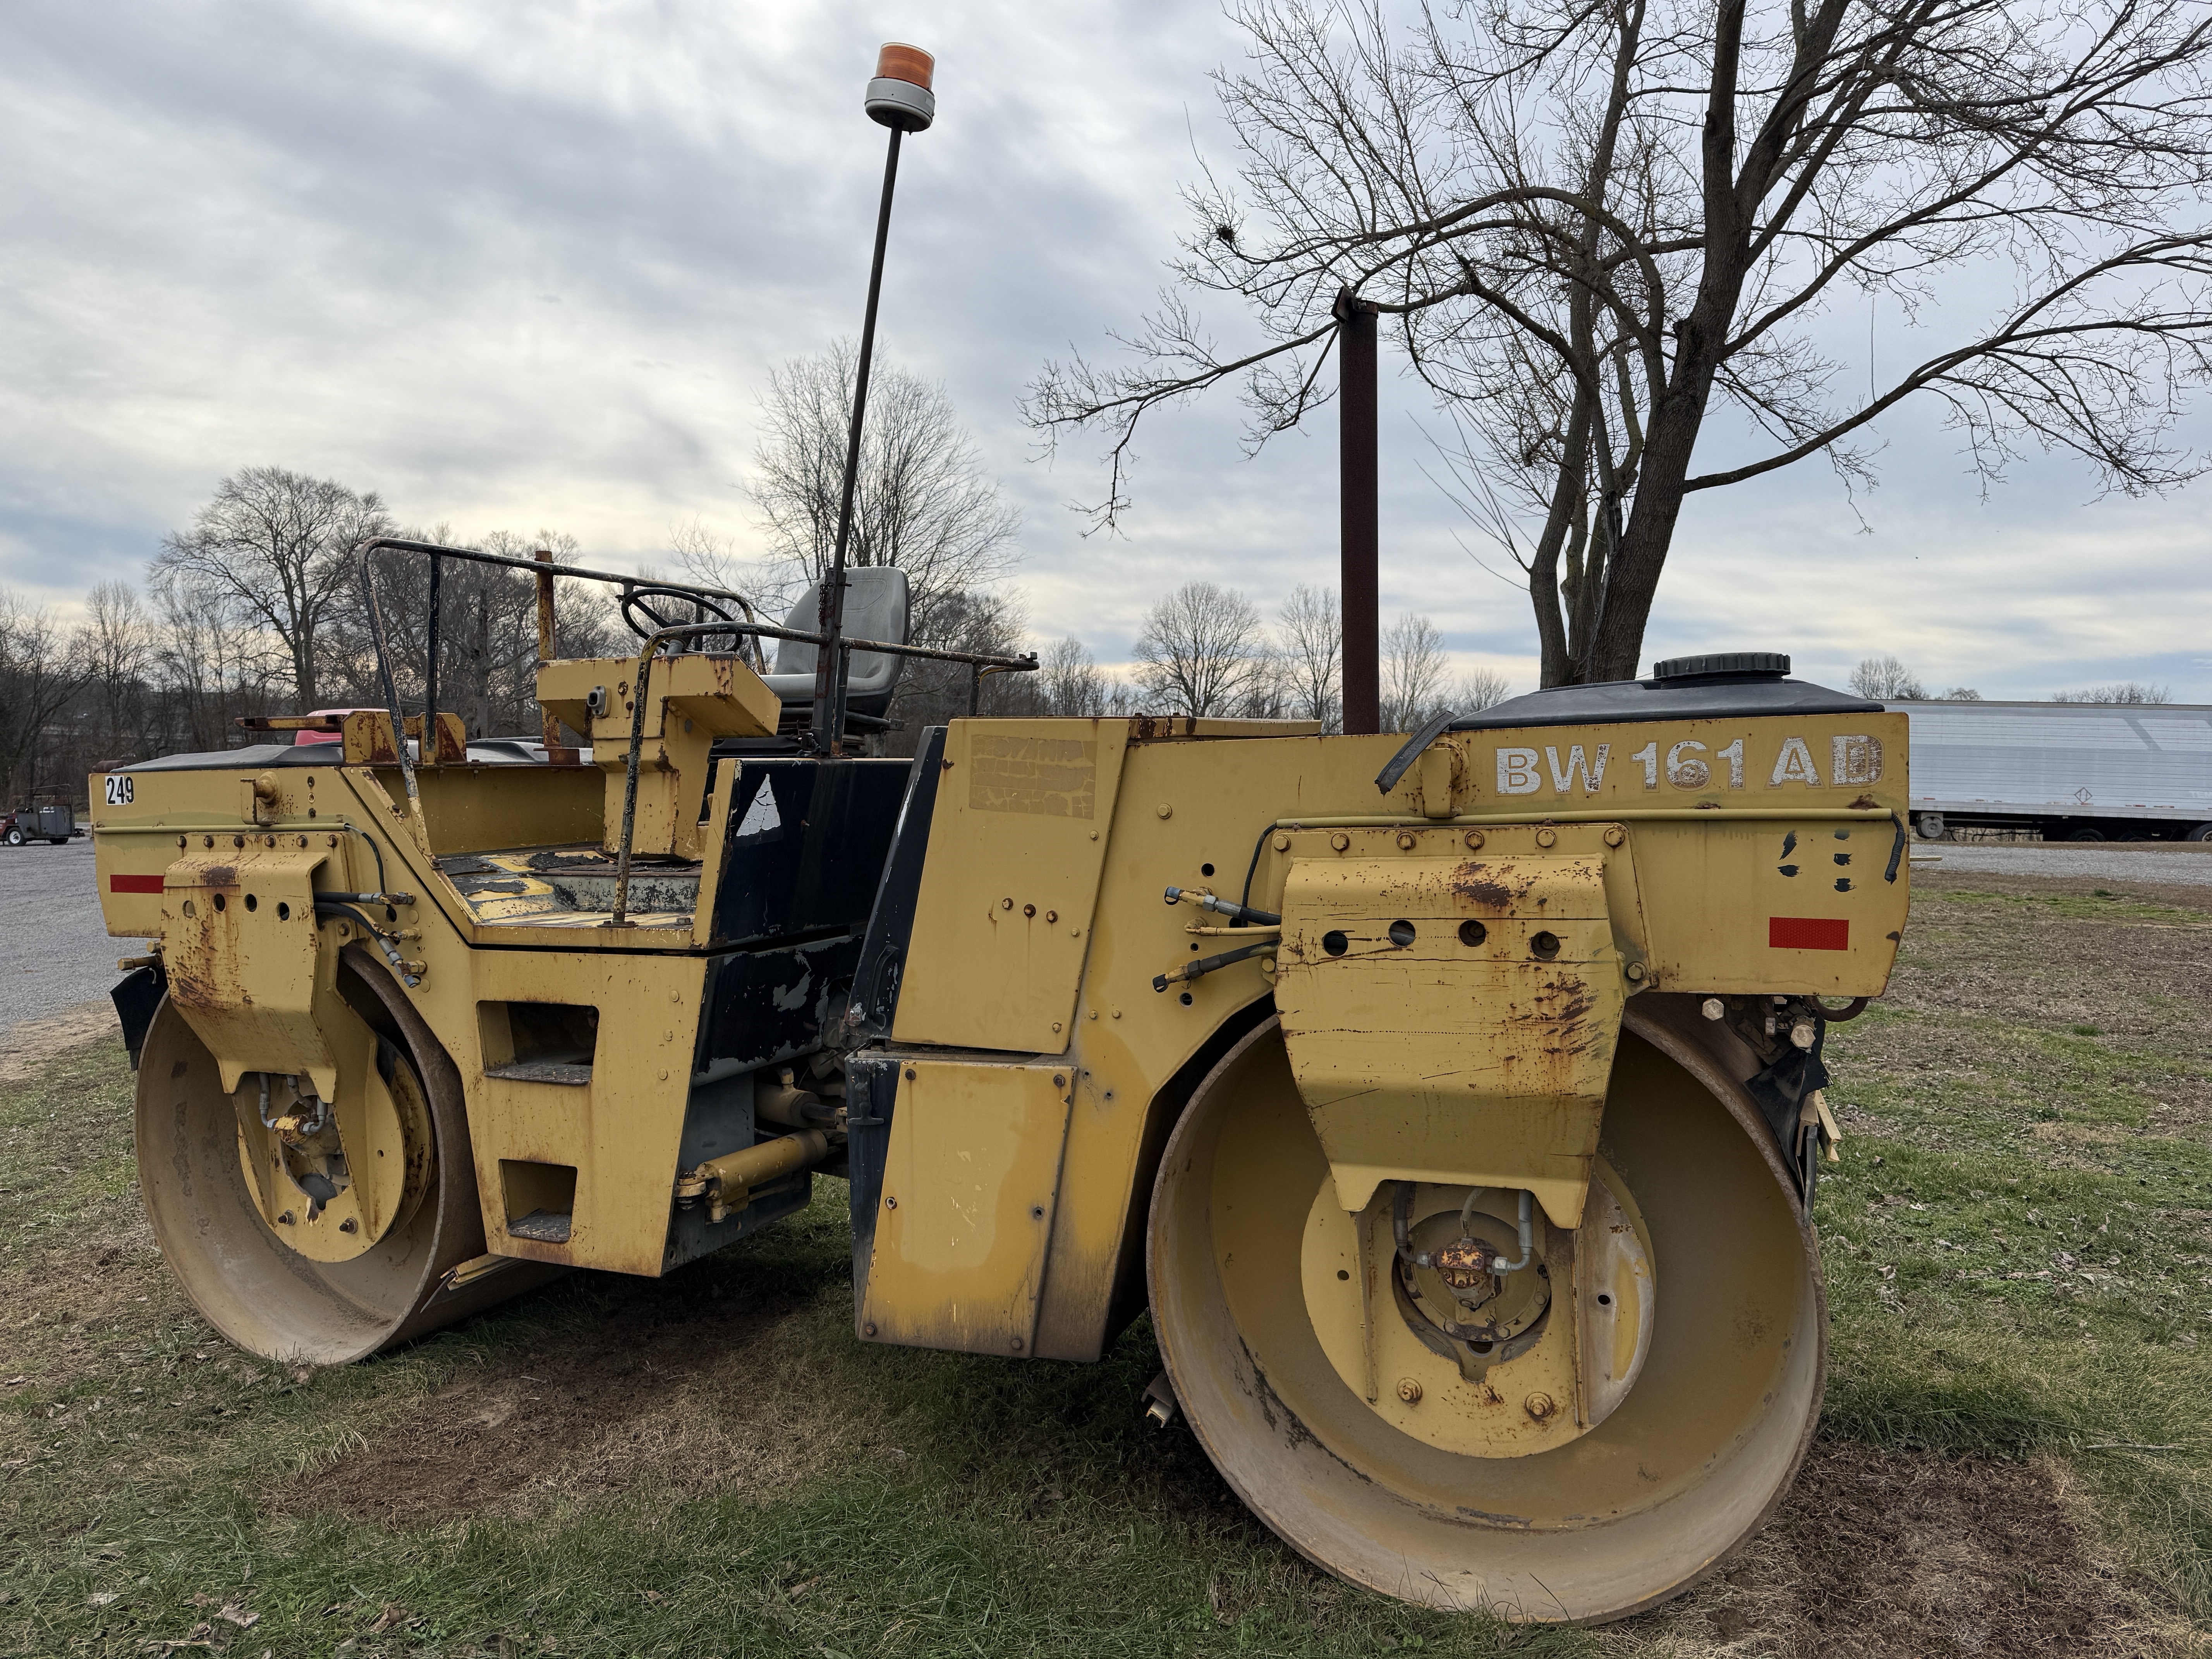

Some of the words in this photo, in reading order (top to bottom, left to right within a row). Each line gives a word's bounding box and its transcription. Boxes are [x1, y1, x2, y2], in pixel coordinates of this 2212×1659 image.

[1496, 743, 1611, 795] BW
[1631, 738, 1744, 791] 161
[1766, 735, 1884, 788] AD
[106, 776, 134, 804] 249
